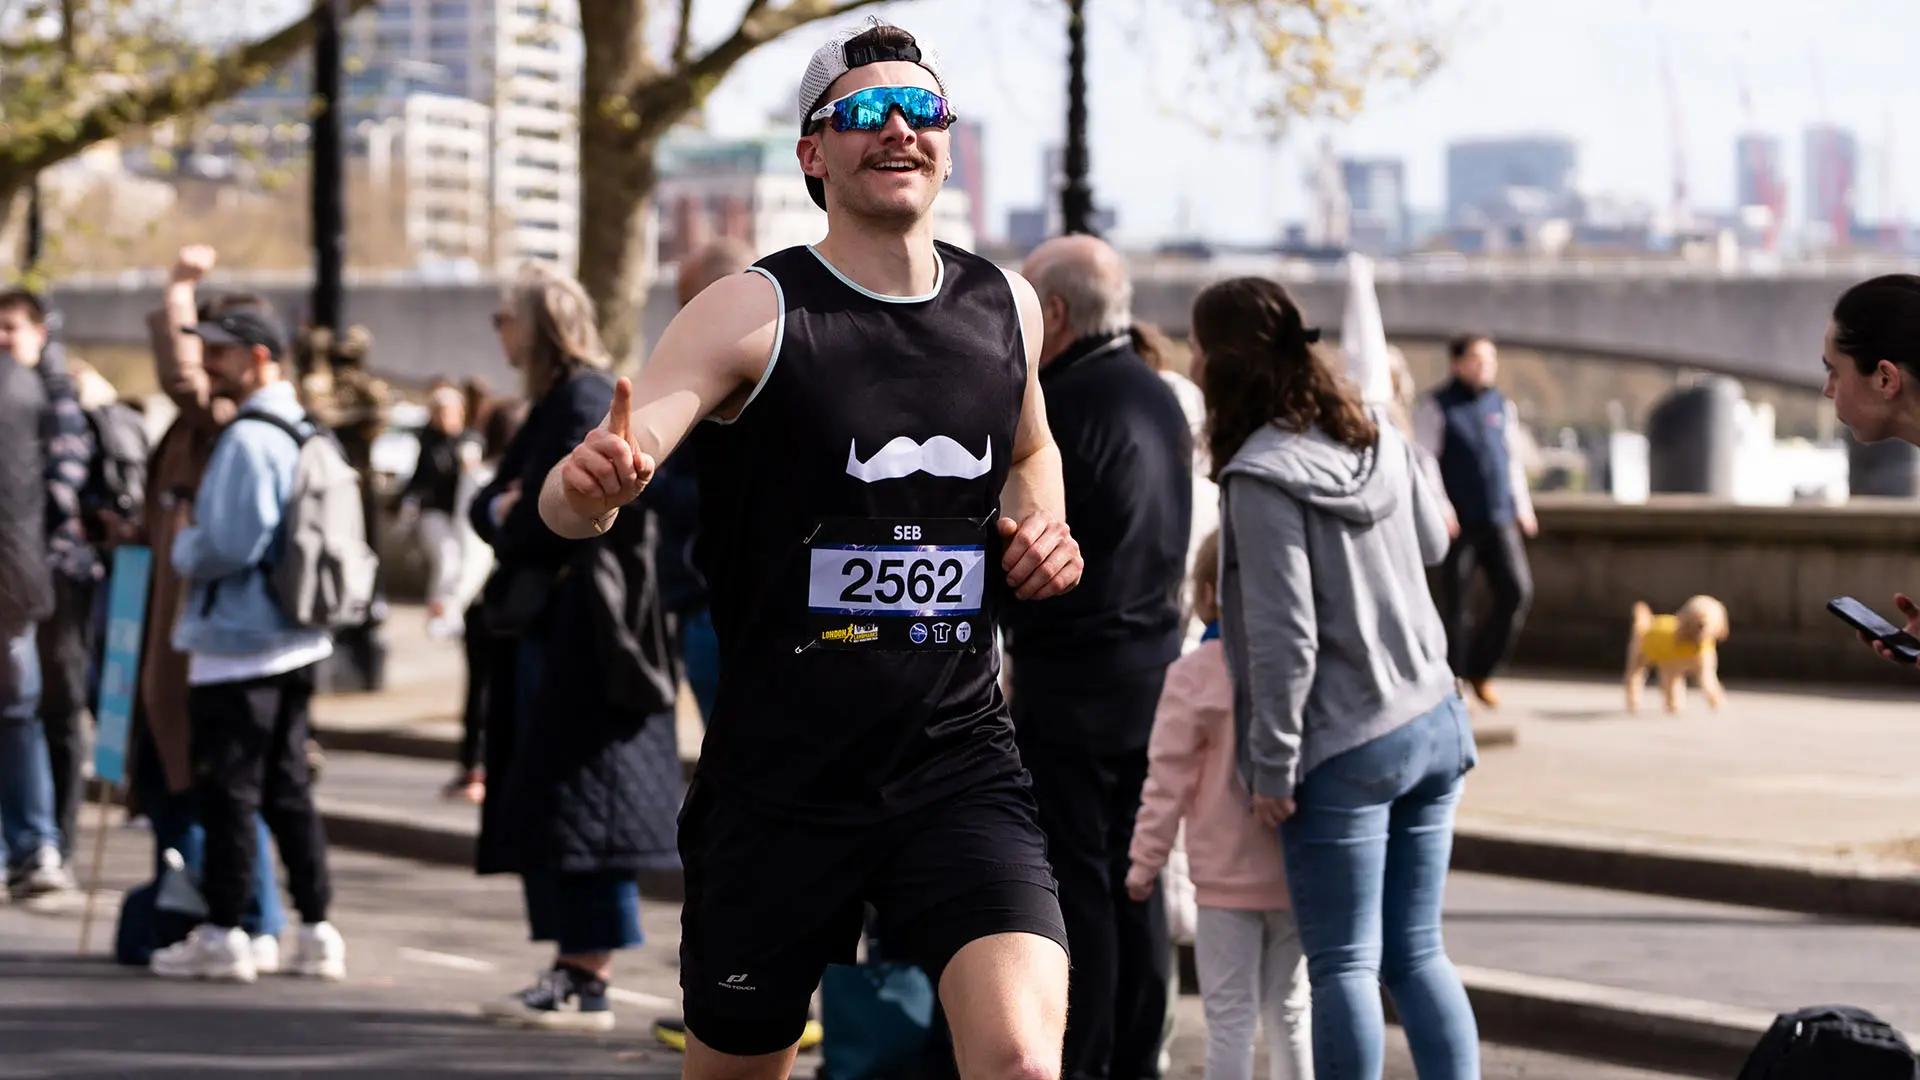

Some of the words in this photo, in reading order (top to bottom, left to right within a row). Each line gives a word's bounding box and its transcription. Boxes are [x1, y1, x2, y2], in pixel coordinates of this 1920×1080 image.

[893, 525, 922, 540] SEB
[840, 558, 963, 604] 2562
[821, 629, 847, 640] LONDON
[939, 627, 944, 640] L
